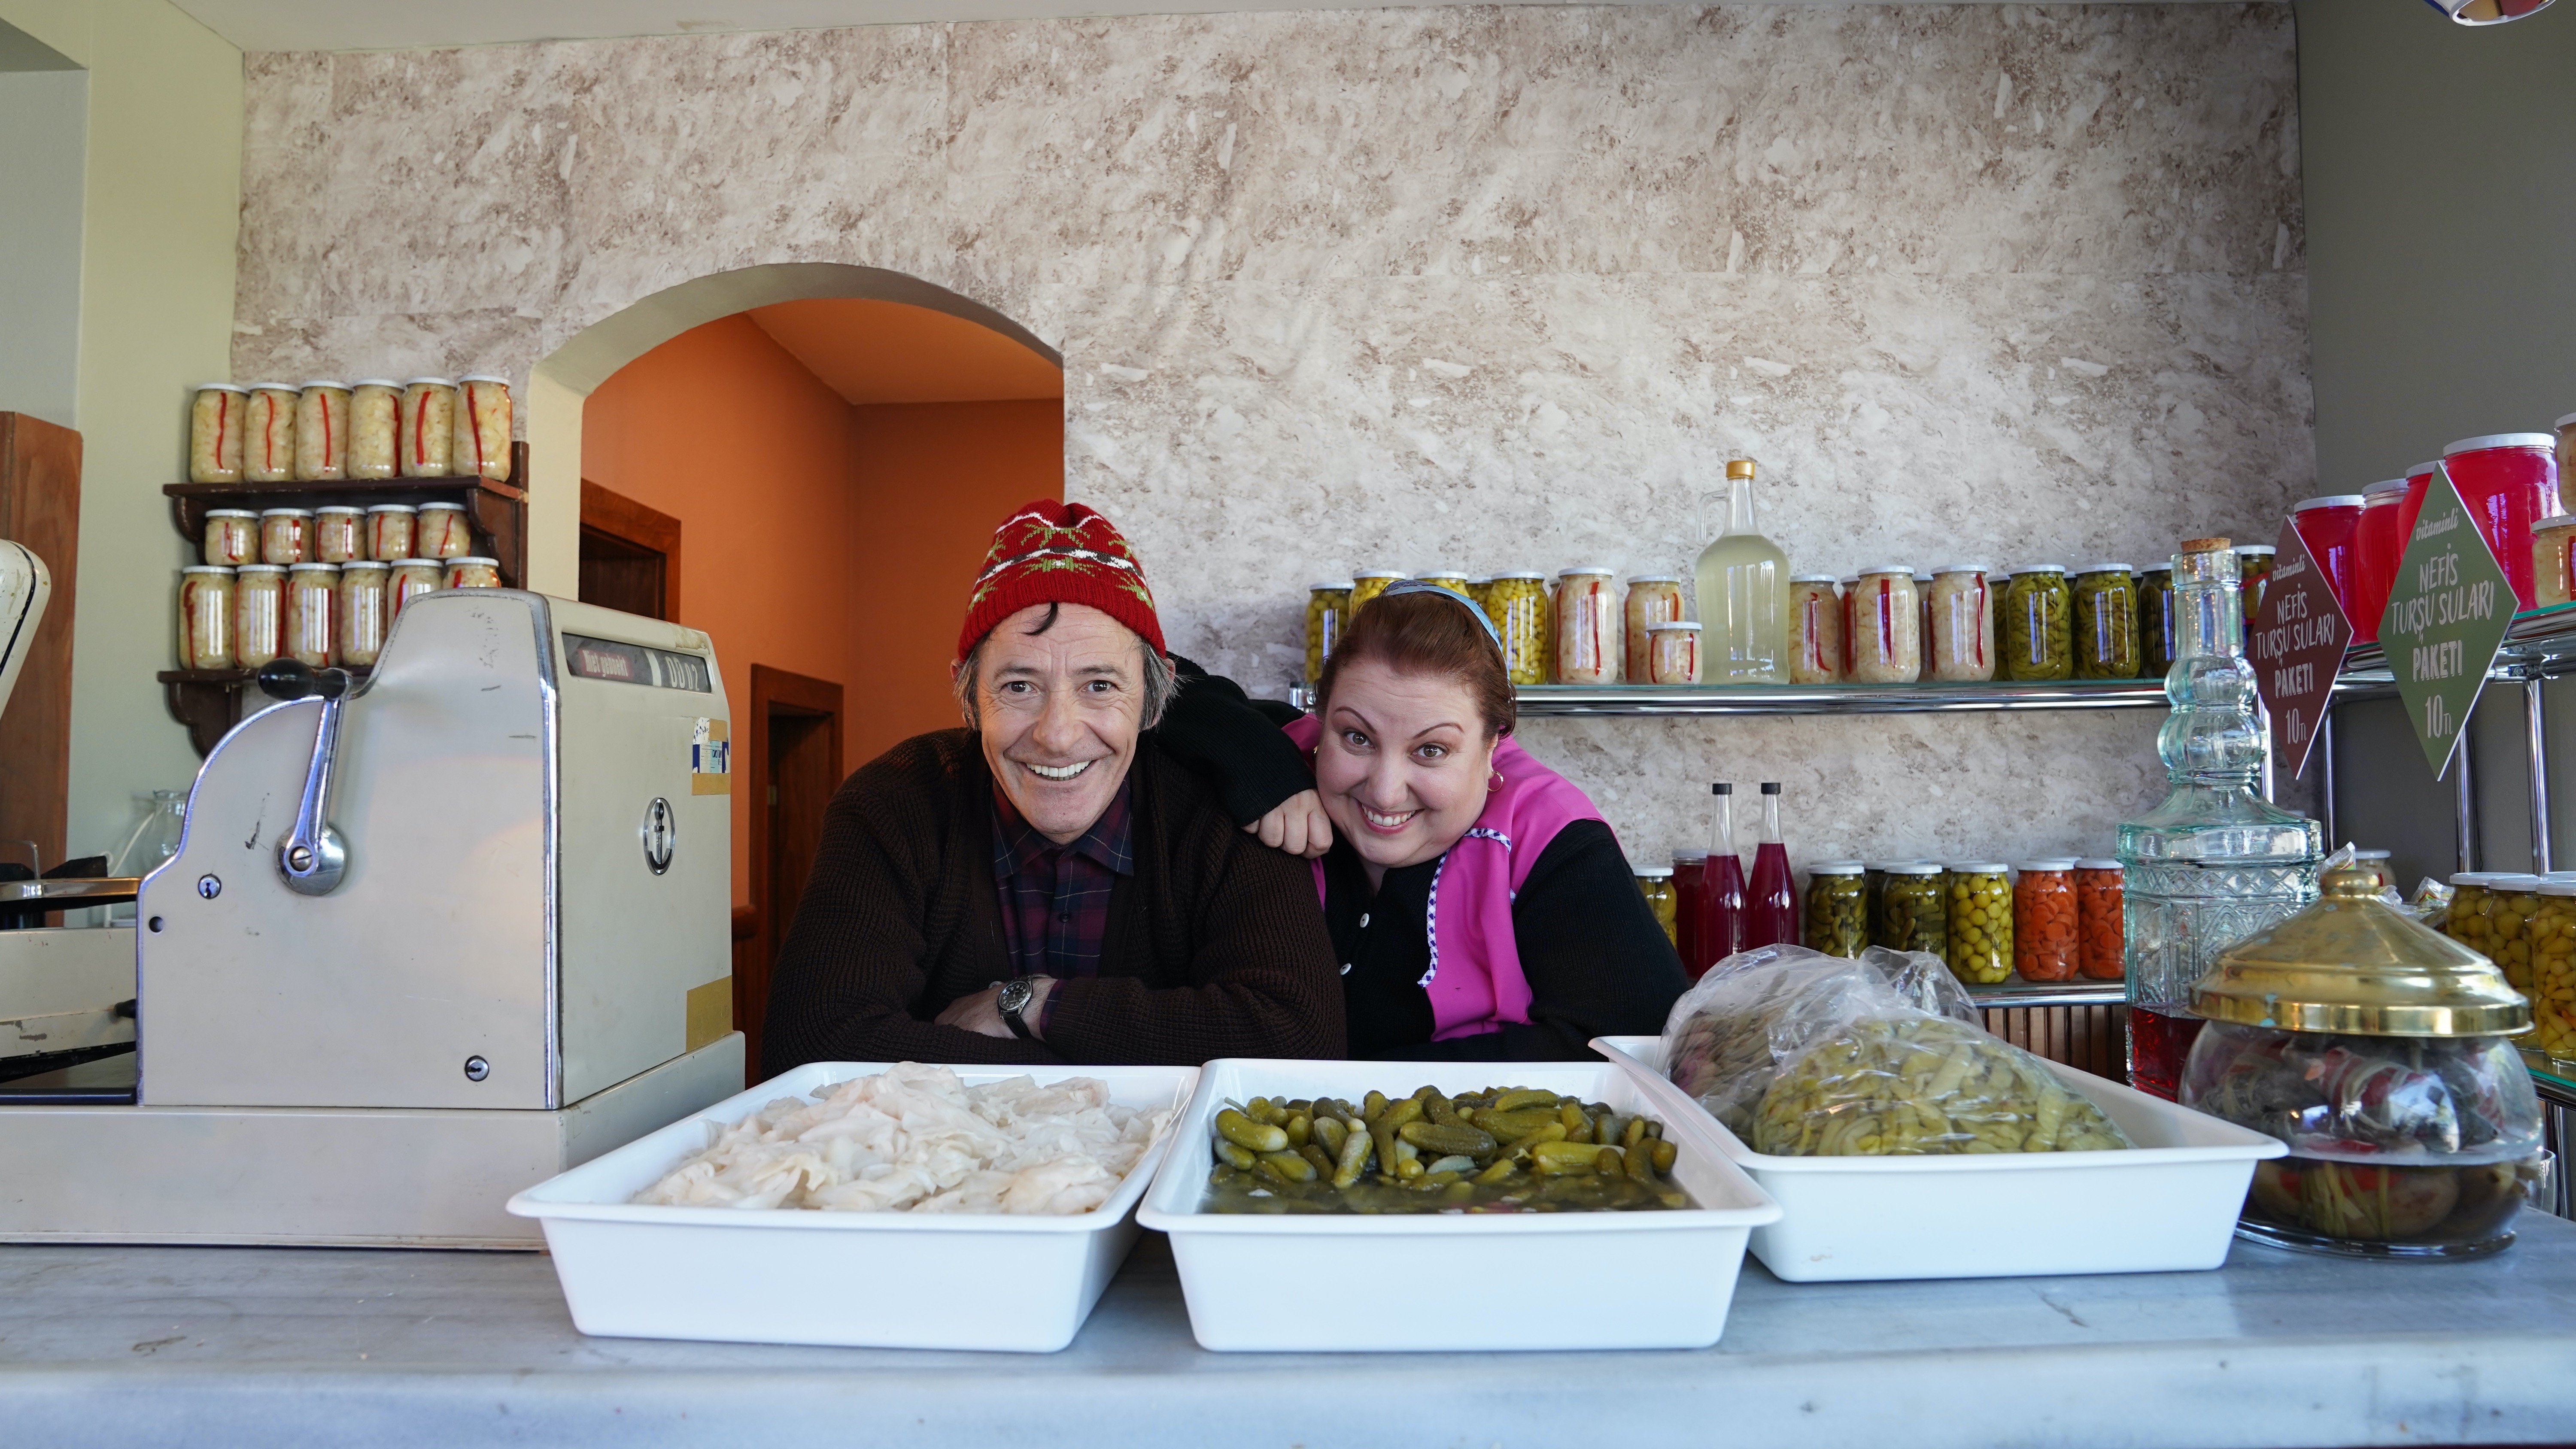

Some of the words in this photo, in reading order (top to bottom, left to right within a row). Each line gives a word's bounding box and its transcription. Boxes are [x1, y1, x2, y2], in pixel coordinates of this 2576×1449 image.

[2416, 507, 2459, 541] vitaminli
[2273, 554, 2306, 582] vitaminli
[2419, 543, 2458, 593] NEFİS
[2277, 583, 2307, 625] NEFİS
[2391, 593, 2435, 644] TURŞU
[2439, 580, 2494, 625] SULARI
[2255, 624, 2290, 667] TURŞU
[2294, 613, 2334, 651] SULARI
